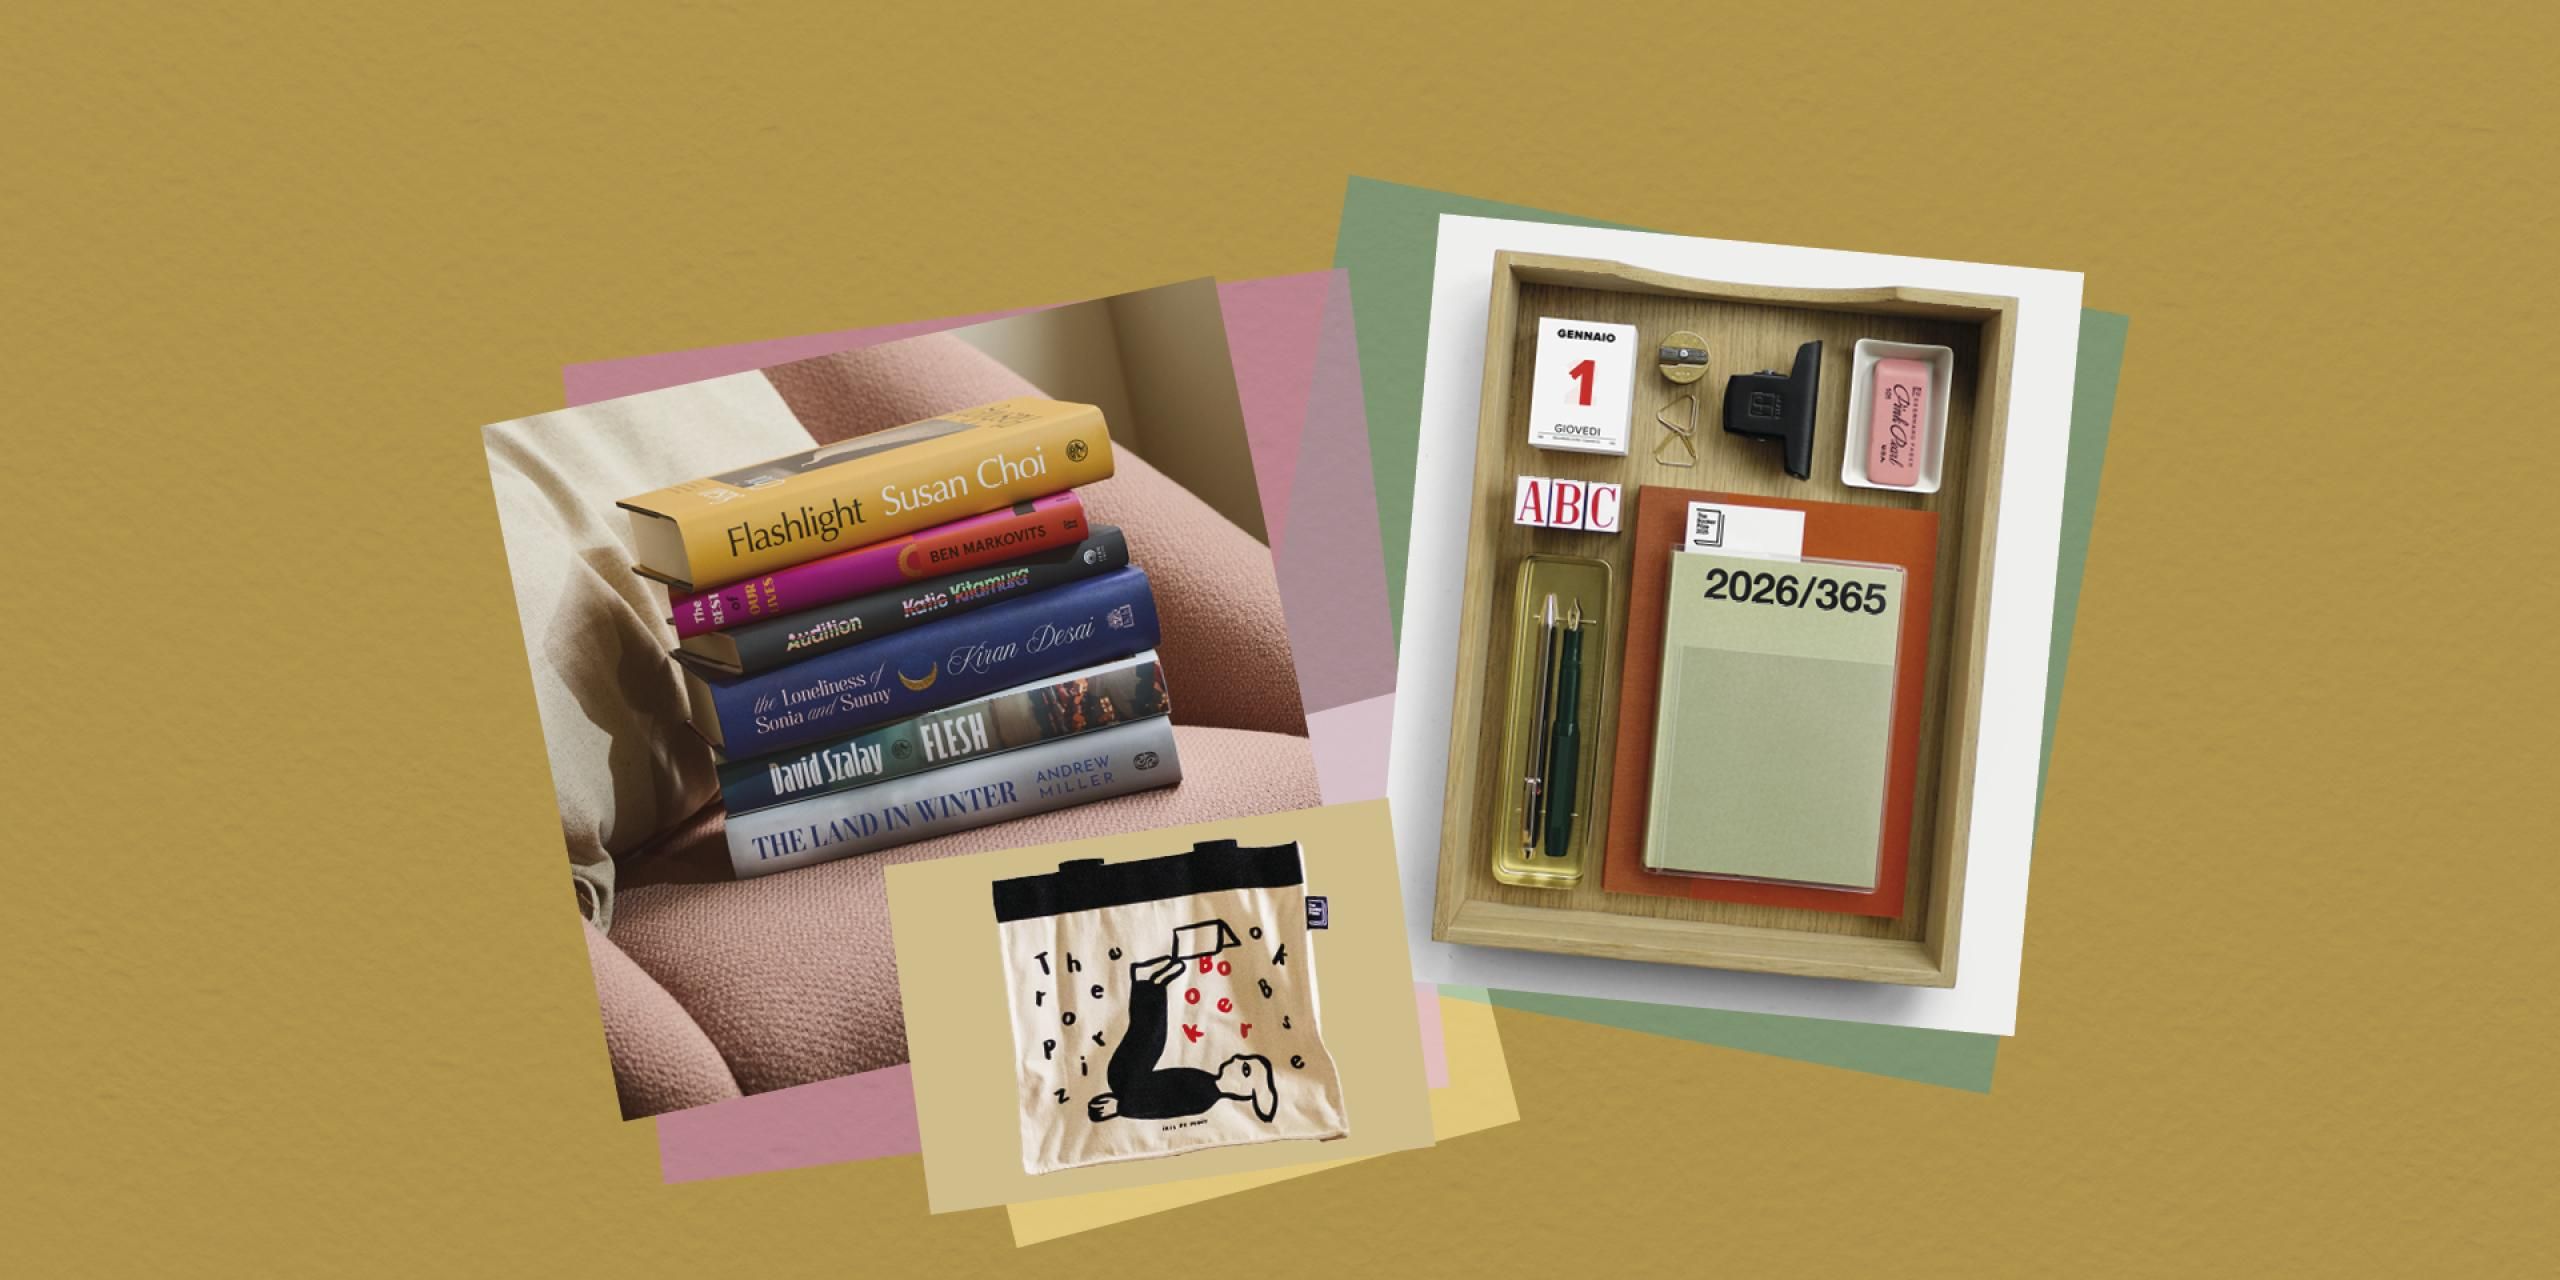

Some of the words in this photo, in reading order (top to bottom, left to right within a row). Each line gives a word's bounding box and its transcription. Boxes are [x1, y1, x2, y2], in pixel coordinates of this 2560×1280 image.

[1557, 328, 1616, 343] GENNAIO
[1569, 359, 1595, 406] 1
[1892, 384, 1910, 425] Pink
[1889, 423, 1908, 469] Pearl
[727, 498, 866, 557] Flashlight
[881, 474, 969, 517] Susan
[976, 446, 1047, 489] Choi
[930, 547, 960, 564] BEN
[963, 525, 1047, 555] MARKOVITS
[692, 599, 705, 625] The
[708, 592, 725, 625] REST
[726, 595, 741, 611] of
[744, 583, 761, 616] OUR
[763, 576, 780, 613] LIVES
[786, 615, 863, 652] Audition
[902, 591, 949, 618] Katie
[949, 567, 1030, 603] Kitamura
[1704, 567, 1888, 615] 2026/365
[947, 640, 1019, 676] Kiran
[1026, 616, 1096, 654] Desai
[754, 691, 777, 715] the
[781, 672, 867, 708] Loneliness
[869, 661, 887, 689] of
[755, 710, 804, 735] Sonia
[807, 696, 839, 721] and
[840, 687, 892, 712] Sunny
[919, 711, 989, 763] FLESH
[769, 751, 823, 796] David
[822, 742, 884, 783] Szalay
[1036, 755, 1110, 784] ANDREW
[1039, 771, 1115, 800] MILLER
[752, 828, 807, 860] THE
[810, 812, 880, 848] LAND
[882, 803, 912, 832] IN
[915, 780, 1018, 825] WINTER
